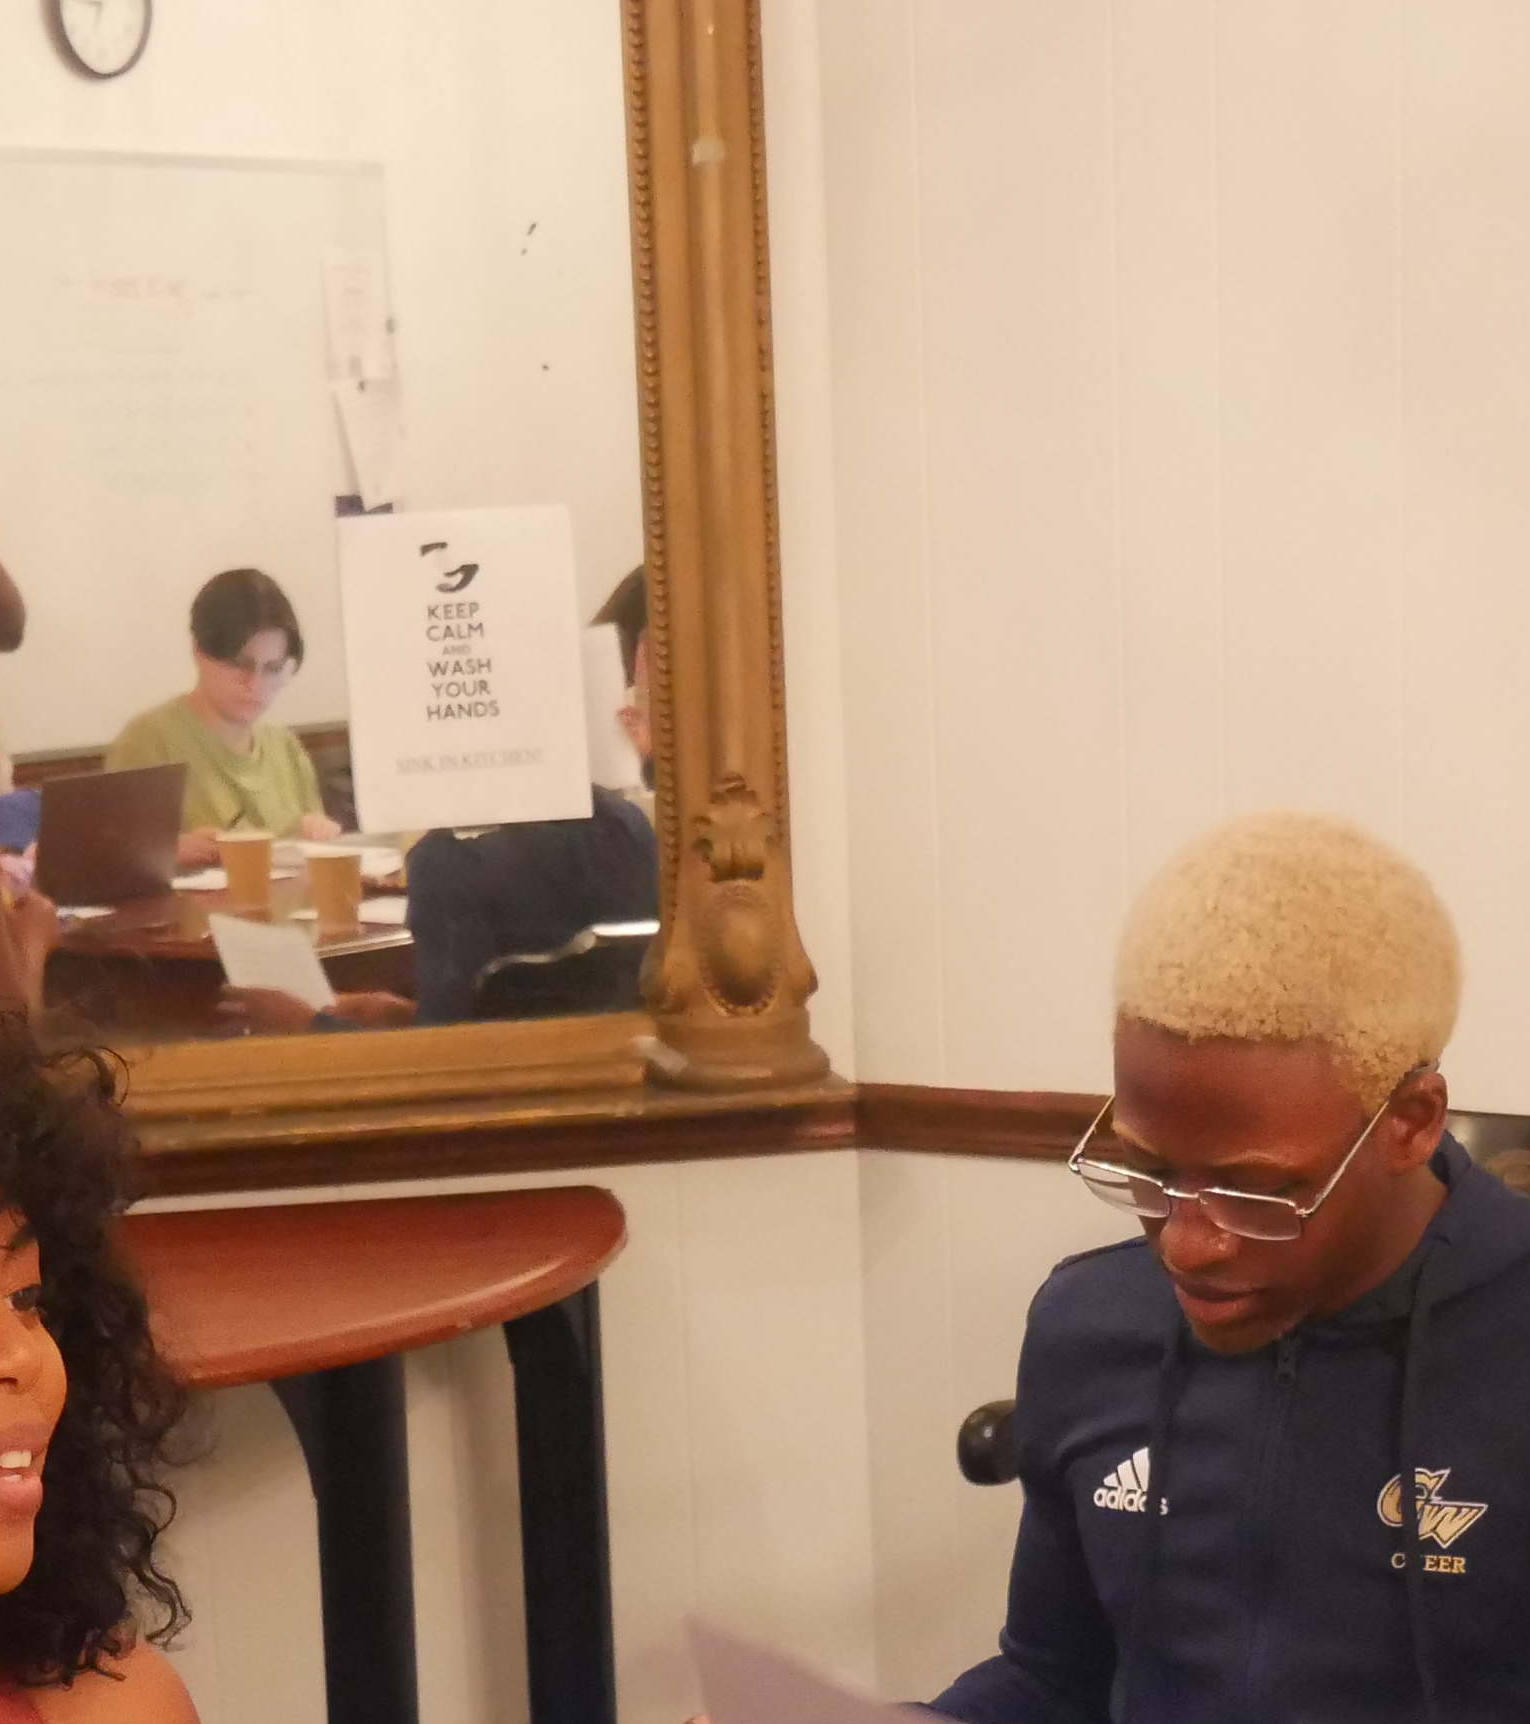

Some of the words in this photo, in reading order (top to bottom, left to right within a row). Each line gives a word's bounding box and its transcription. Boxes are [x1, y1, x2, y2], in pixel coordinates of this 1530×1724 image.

[426, 601, 479, 621] KEEP
[426, 621, 484, 642] CALM
[441, 643, 471, 656] AND
[426, 657, 491, 677] WASH
[431, 678, 490, 699] YOUR
[426, 699, 499, 721] HANDS
[1391, 1553, 1466, 1573] CEER
